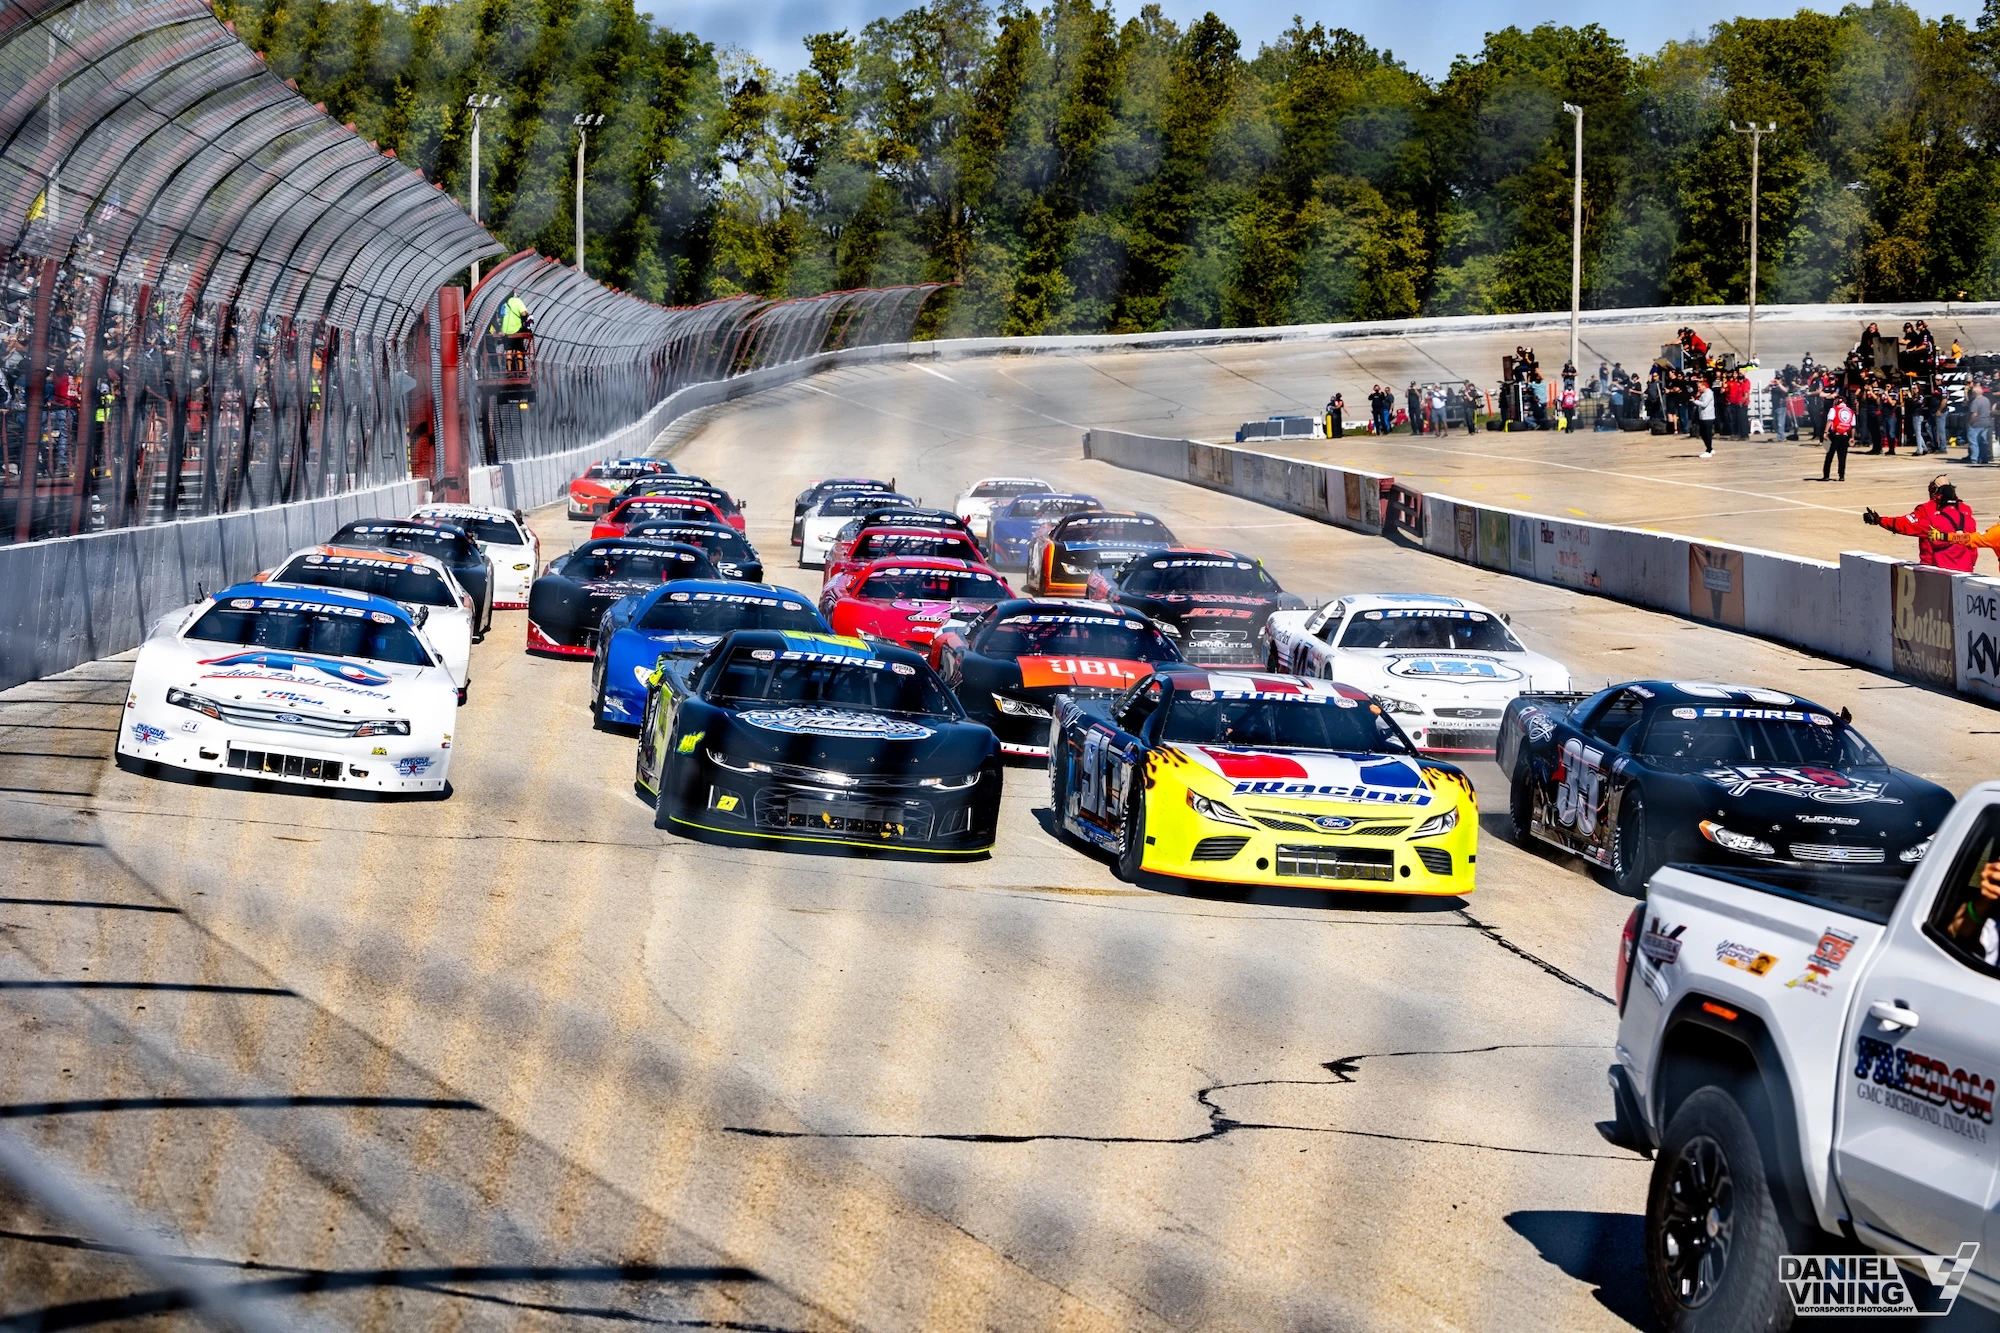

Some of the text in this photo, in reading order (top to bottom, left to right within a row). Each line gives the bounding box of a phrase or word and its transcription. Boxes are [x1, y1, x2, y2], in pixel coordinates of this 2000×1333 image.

[892, 515, 943, 523] STARS
[370, 526, 437, 536] STARS
[659, 528, 716, 537] STARS
[888, 534, 944, 543] STARS
[609, 548, 676, 558] STARS
[326, 556, 408, 570] STARS
[1170, 560, 1235, 568] STARS
[903, 568, 972, 578] STARS
[693, 593, 778, 607] STARS
[259, 600, 366, 617] STARS
[1894, 565, 1952, 651] Botkin
[1966, 594, 1997, 621] DAVE
[1037, 615, 1121, 626] STARS
[1386, 610, 1465, 619] STARS
[1188, 641, 1239, 649] CHEVROLET
[780, 651, 886, 669] STARS
[212, 669, 263, 678] Auto
[1047, 660, 1136, 679] JBL
[1408, 660, 1498, 677] 131
[1221, 690, 1327, 704] STARS
[1702, 708, 1804, 721] STARS
[1232, 781, 1433, 806] iRacing
[1322, 817, 1345, 828] Ford
[1728, 835, 1756, 849] 35
[1854, 1035, 1995, 1126] FREEDOM
[1857, 1082, 1987, 1144] GMC RICHMOND, INDIANA
